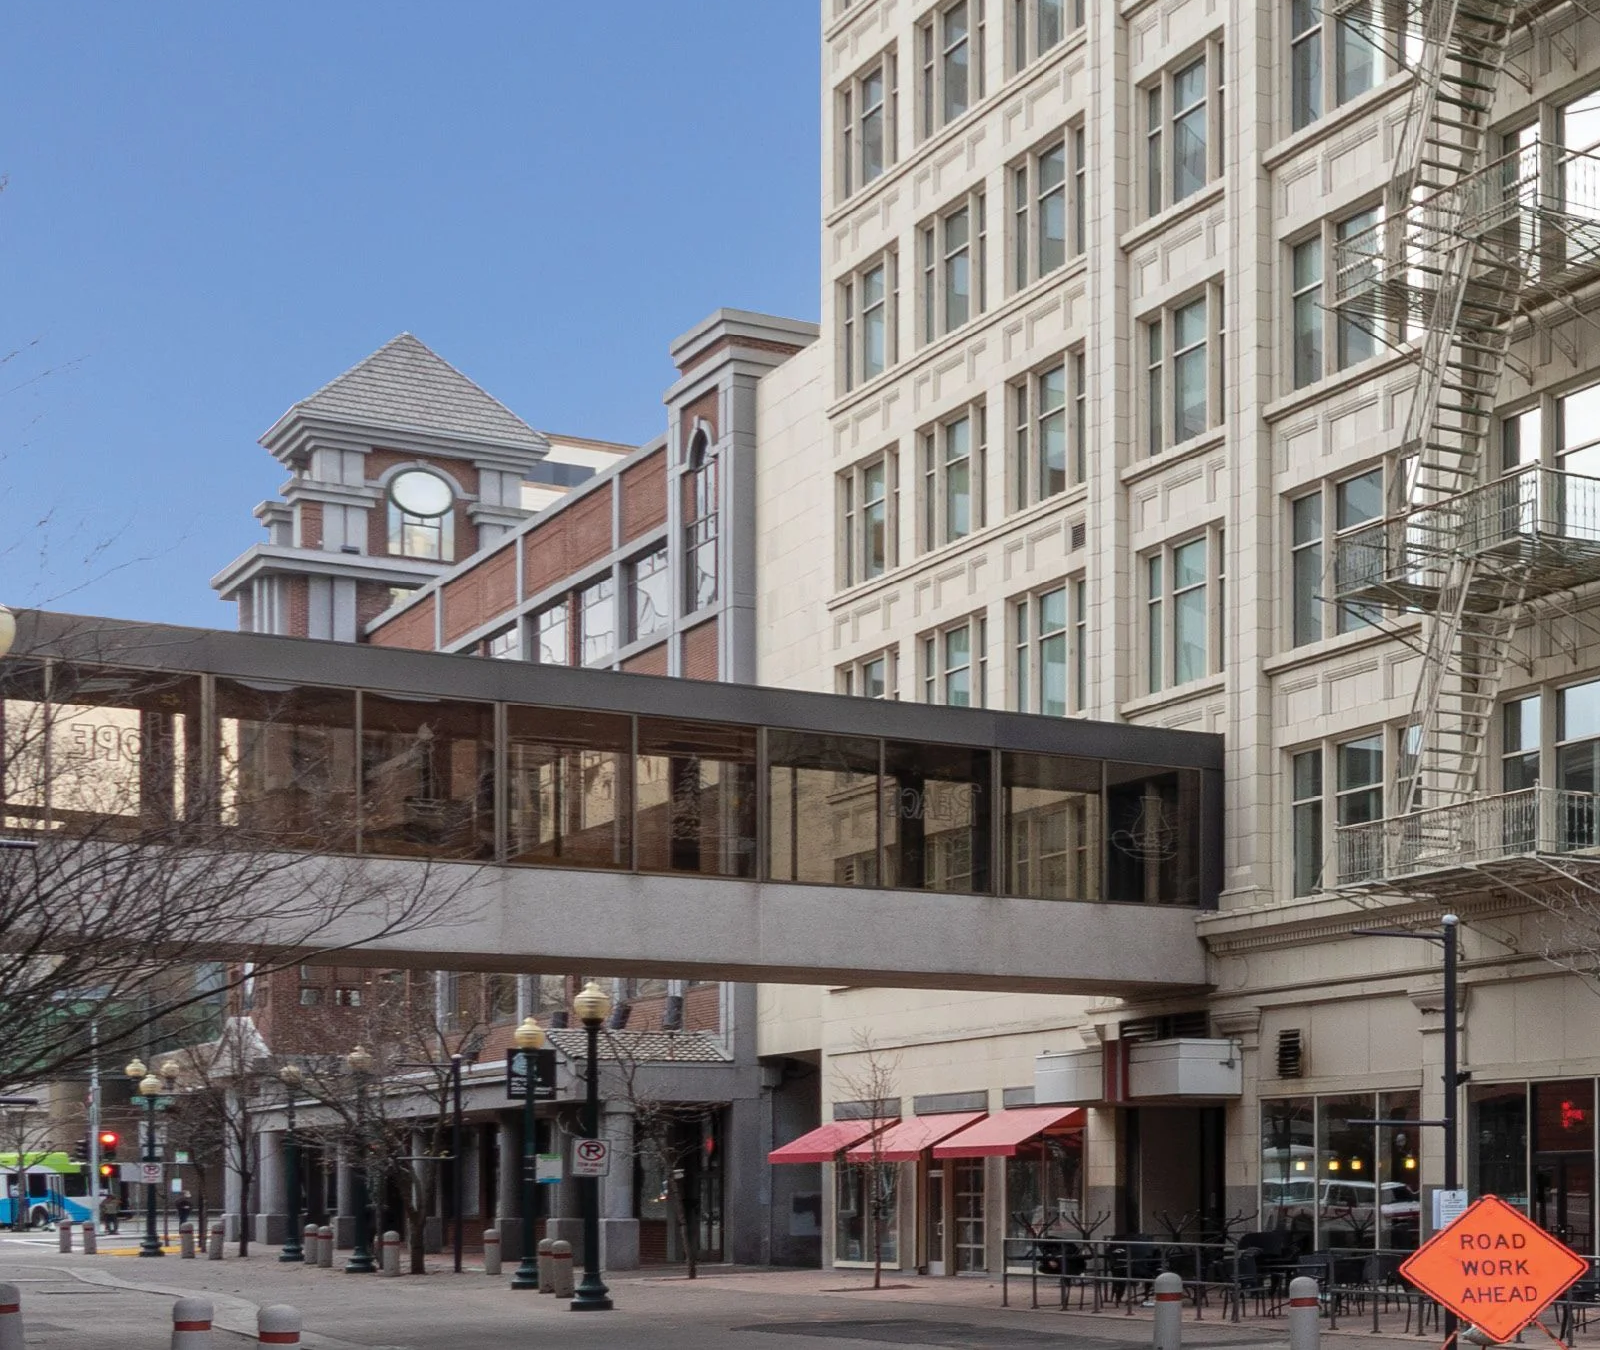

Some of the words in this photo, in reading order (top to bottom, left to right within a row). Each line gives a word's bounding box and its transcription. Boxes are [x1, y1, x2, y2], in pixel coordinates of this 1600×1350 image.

[1460, 1234, 1526, 1250] ROAD
[1461, 1259, 1530, 1276] WORK
[1461, 1286, 1538, 1303] AHEAD
